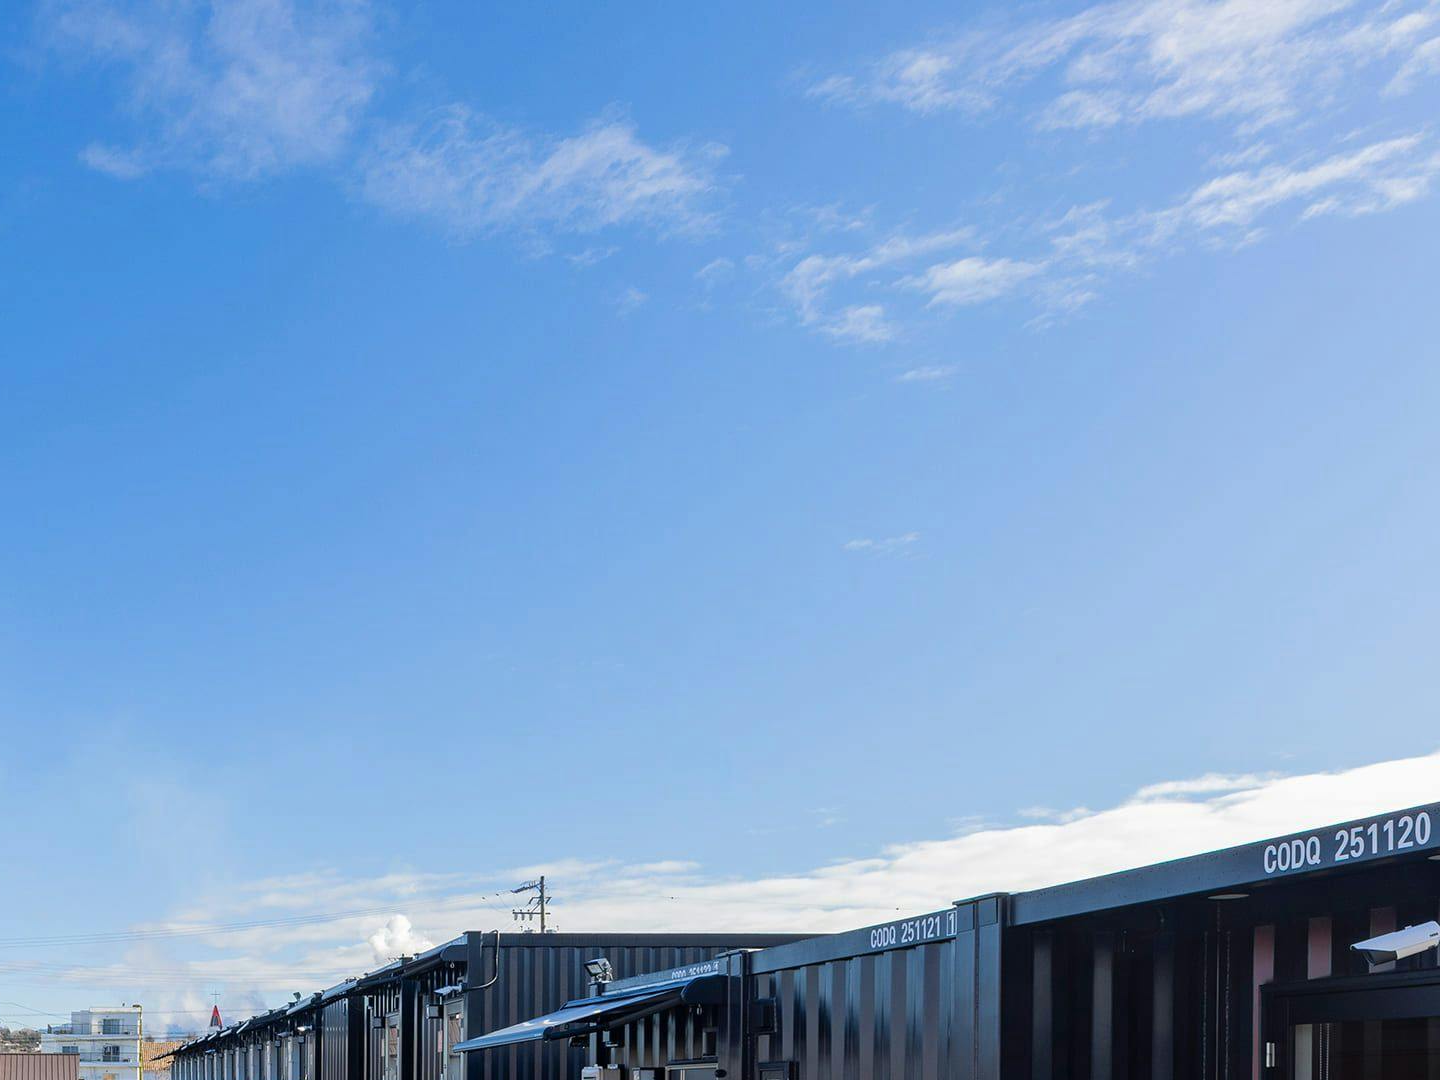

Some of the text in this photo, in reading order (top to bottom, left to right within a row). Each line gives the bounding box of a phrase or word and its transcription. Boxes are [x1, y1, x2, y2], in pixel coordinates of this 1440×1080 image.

[1263, 812, 1431, 874] CODQ 251120
[870, 925, 897, 949] CODQ
[901, 915, 941, 943] 251121
